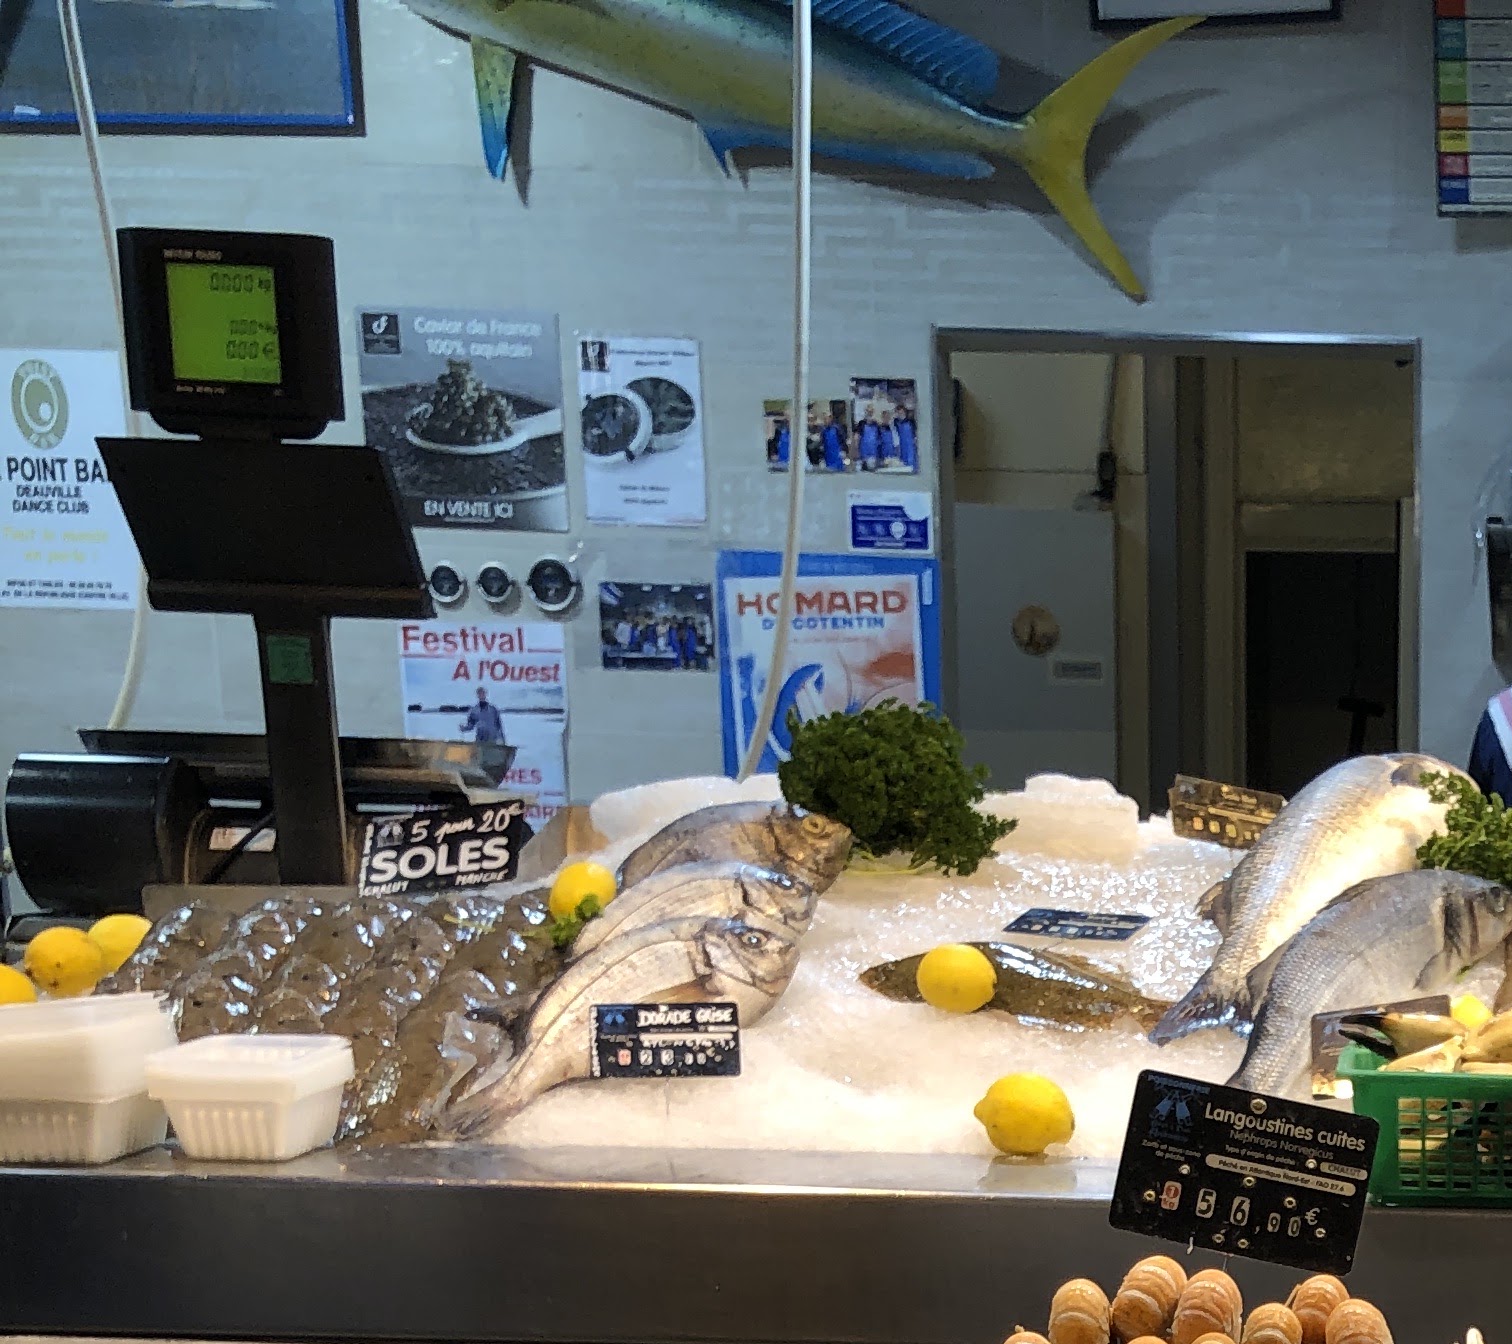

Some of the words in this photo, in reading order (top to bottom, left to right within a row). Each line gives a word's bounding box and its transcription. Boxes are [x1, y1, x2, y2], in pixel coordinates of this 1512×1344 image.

[466, 319, 486, 334] de
[490, 320, 542, 336] France
[7, 457, 67, 482] POINT
[17, 485, 82, 498] DEAUVILLE
[12, 499, 54, 513] DANCE
[57, 501, 90, 514] CLUB
[424, 501, 444, 516] EN
[494, 502, 513, 518] ICI
[738, 590, 907, 616] HOMARD
[402, 625, 524, 655] Festival
[478, 661, 561, 683] l'Ouest
[410, 819, 431, 843] 5
[369, 836, 510, 882] SOLES
[1205, 1102, 1313, 1141] Langoustines
[1317, 1130, 1366, 1152] cuites
[1229, 1130, 1277, 1150] Nephrops
[1280, 1138, 1334, 1160] Norvegicus
